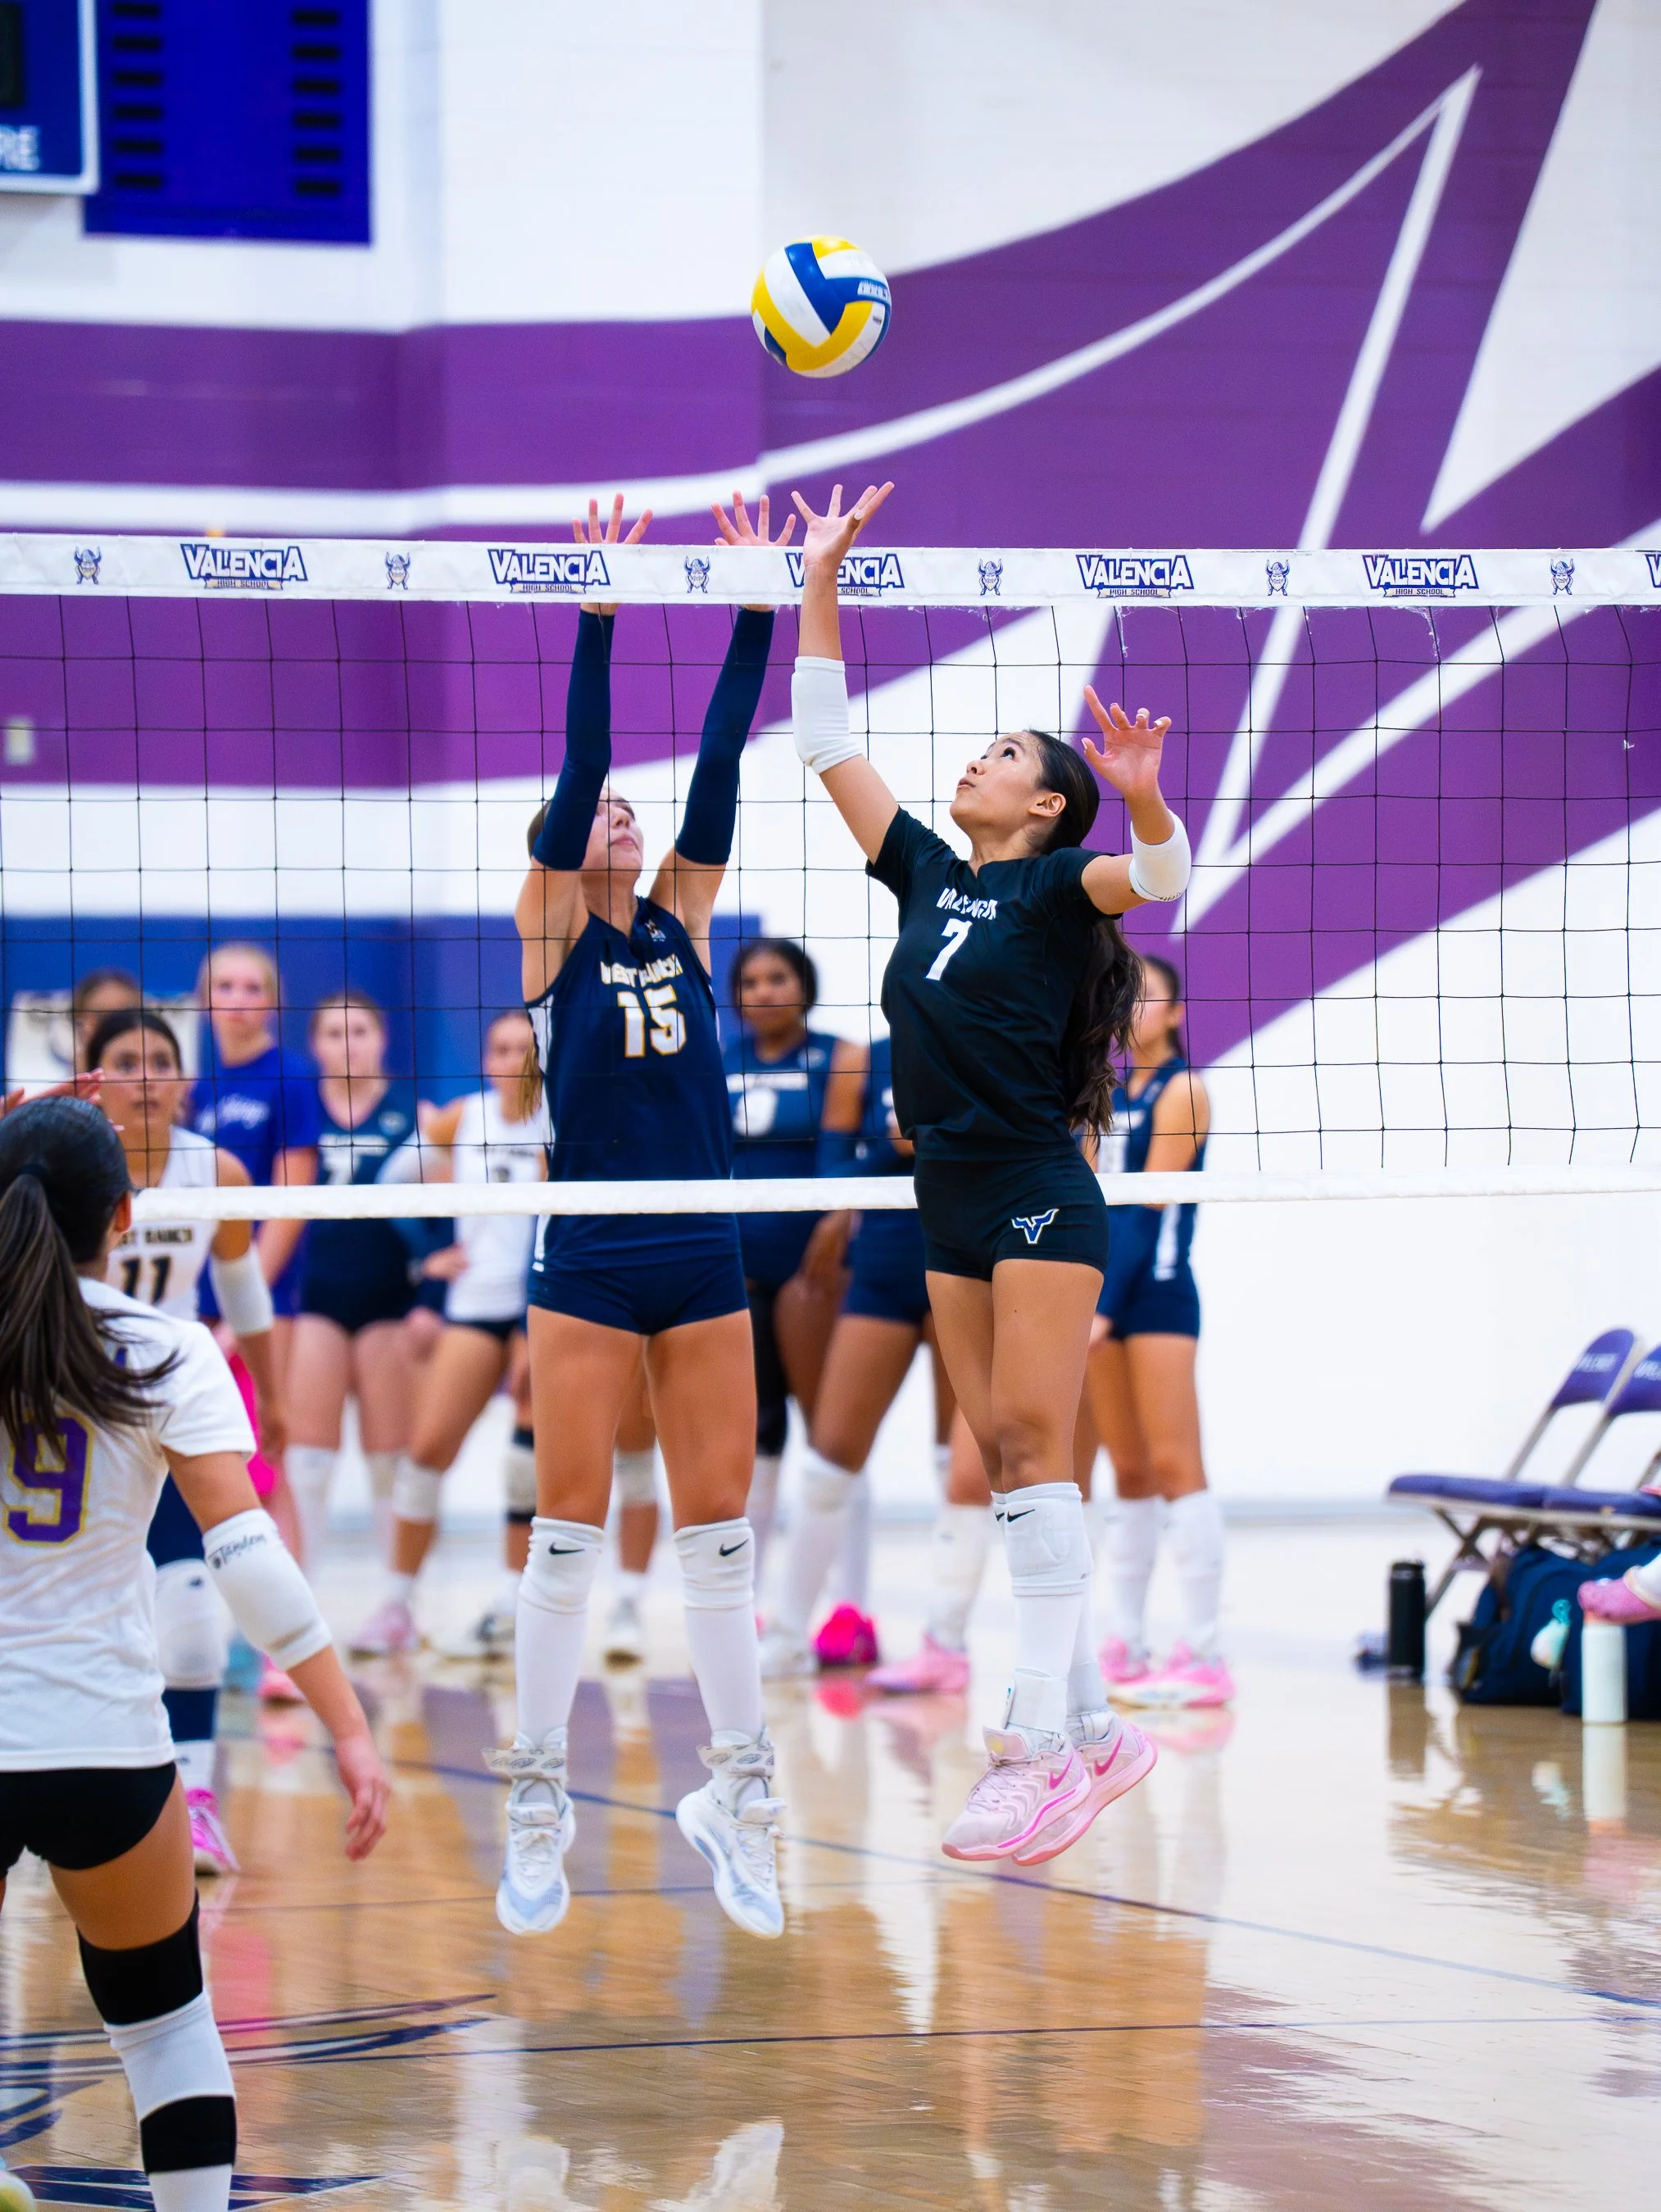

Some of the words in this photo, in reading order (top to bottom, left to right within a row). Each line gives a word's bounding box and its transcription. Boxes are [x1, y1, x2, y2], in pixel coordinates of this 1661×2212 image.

[180, 544, 308, 581] VALENCIA
[488, 549, 610, 586] VALENCIA
[785, 552, 905, 588] VENCIA
[1076, 555, 1195, 589] VALENCIA
[1362, 555, 1479, 589] VALENCIA
[545, 584, 574, 592] SCHOOL
[925, 918, 973, 981] 7
[617, 984, 687, 1058] 15
[120, 1254, 172, 1307] 11
[3, 1410, 95, 1548] 9
